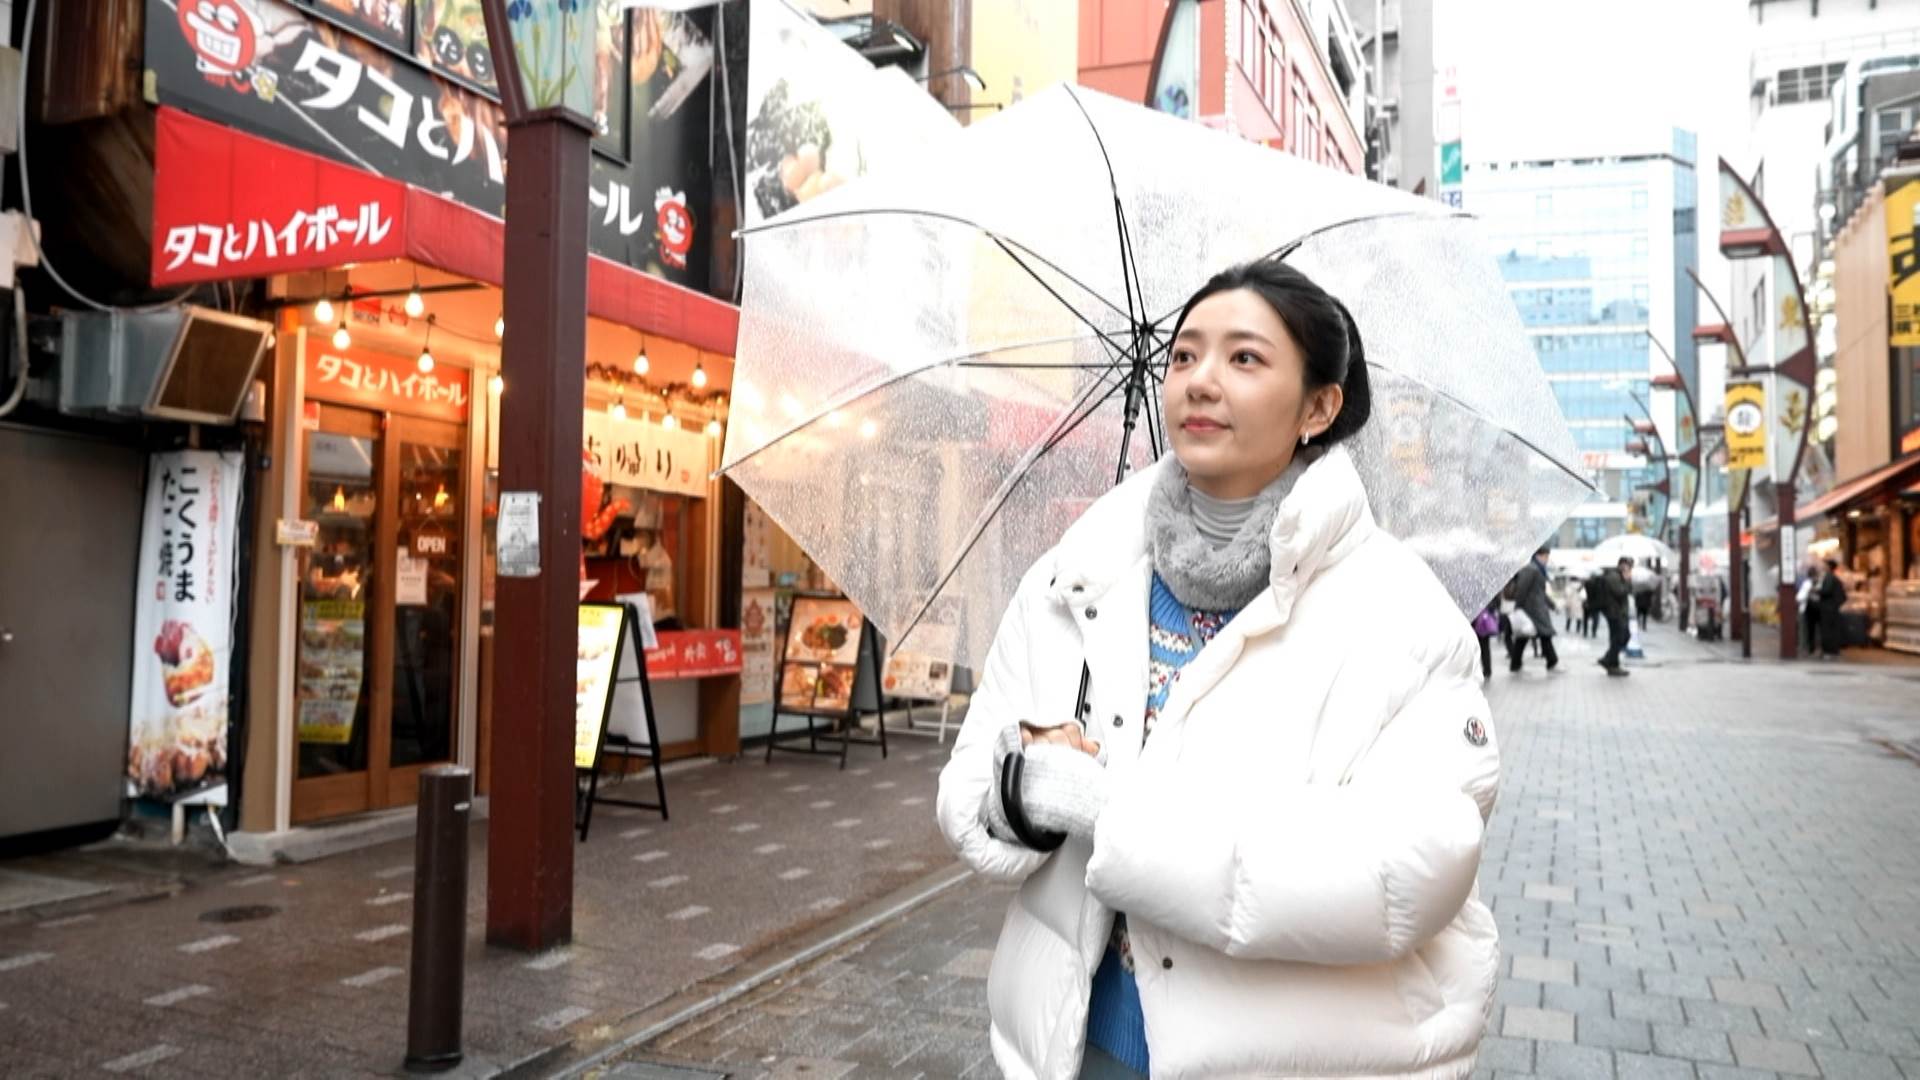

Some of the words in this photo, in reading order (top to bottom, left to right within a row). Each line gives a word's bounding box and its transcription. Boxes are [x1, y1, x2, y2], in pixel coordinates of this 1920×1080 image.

[163, 201, 392, 270] タコとハイボール
[317, 354, 467, 406] タコとハイボール
[174, 467, 199, 603] こくうま
[417, 536, 446, 553] OPEN
